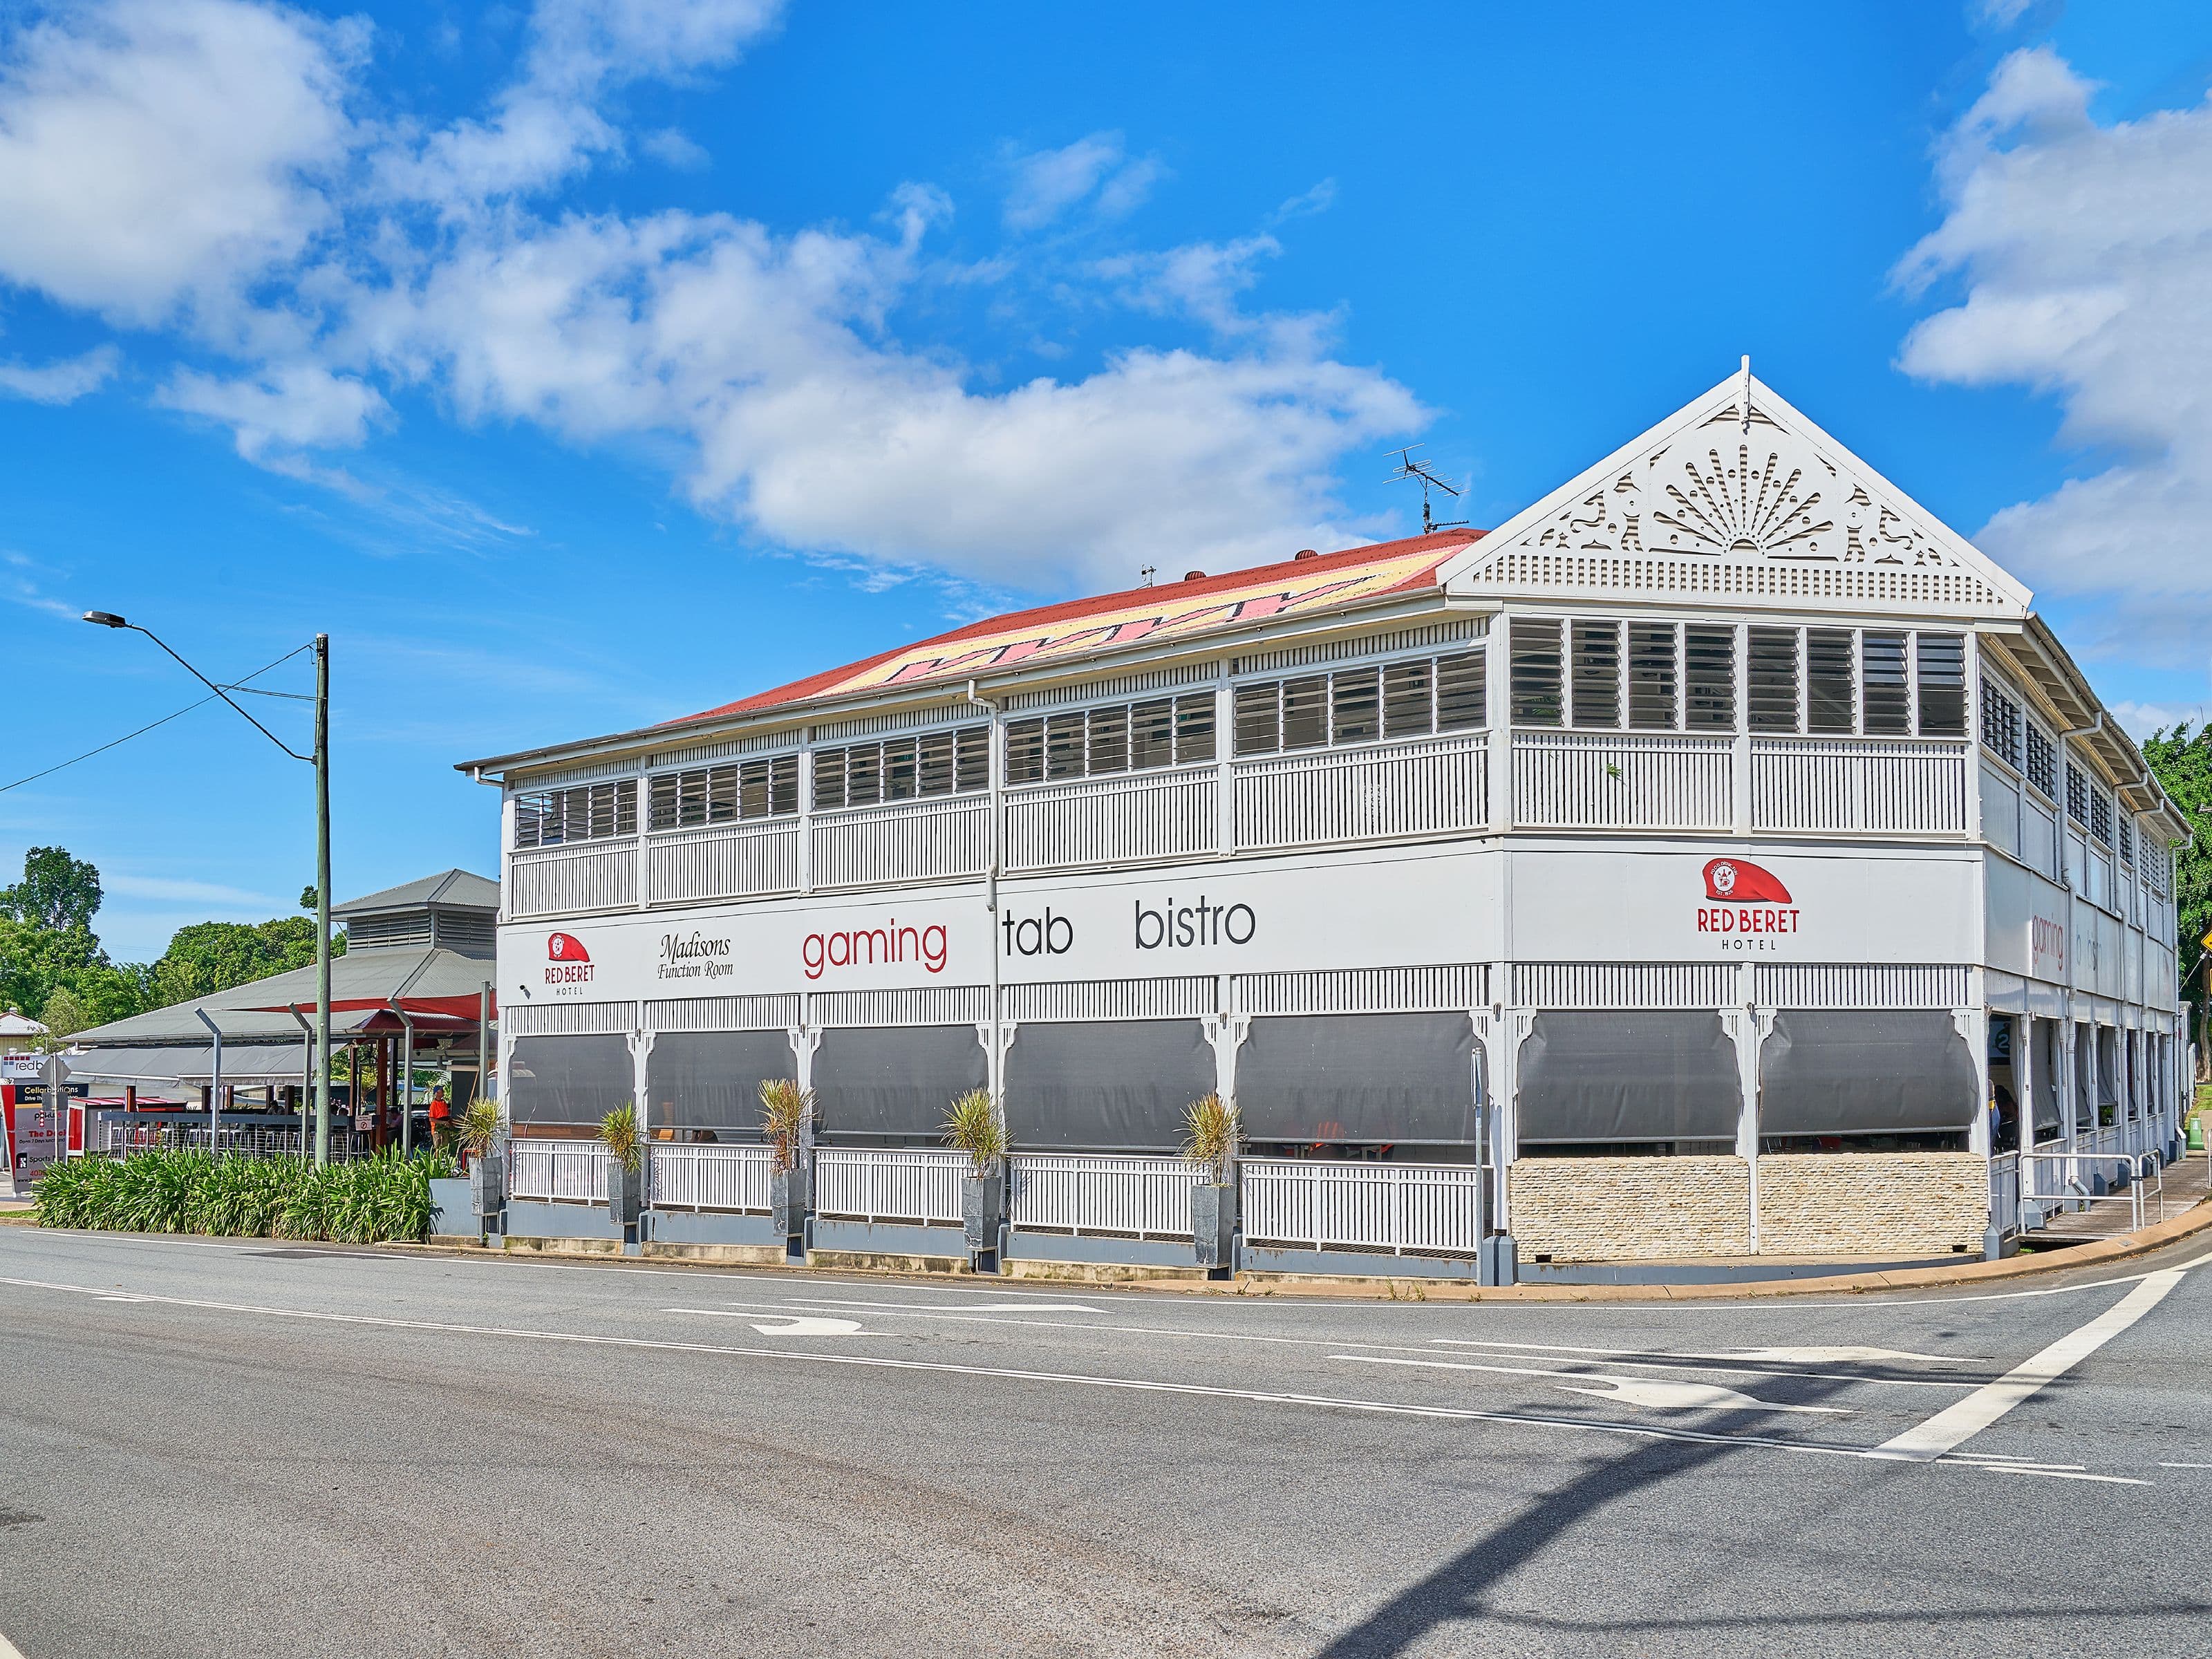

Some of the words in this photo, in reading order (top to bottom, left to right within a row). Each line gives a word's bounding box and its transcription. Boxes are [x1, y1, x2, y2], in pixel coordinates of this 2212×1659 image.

[1002, 906, 1074, 956] tab
[1135, 895, 1256, 949] bistro
[1697, 908, 1735, 932] RED
[1738, 908, 1800, 933] BERET
[659, 930, 731, 964] Madisons
[803, 919, 947, 980] gaming
[1721, 939, 1776, 950] HOTEL
[2032, 912, 2064, 972] gaming
[545, 967, 563, 984] RED
[565, 964, 595, 983] BERET
[657, 962, 701, 980] Function
[704, 960, 733, 980] Room
[556, 986, 583, 996] HOTEL
[29, 1155, 50, 1163] Sports
